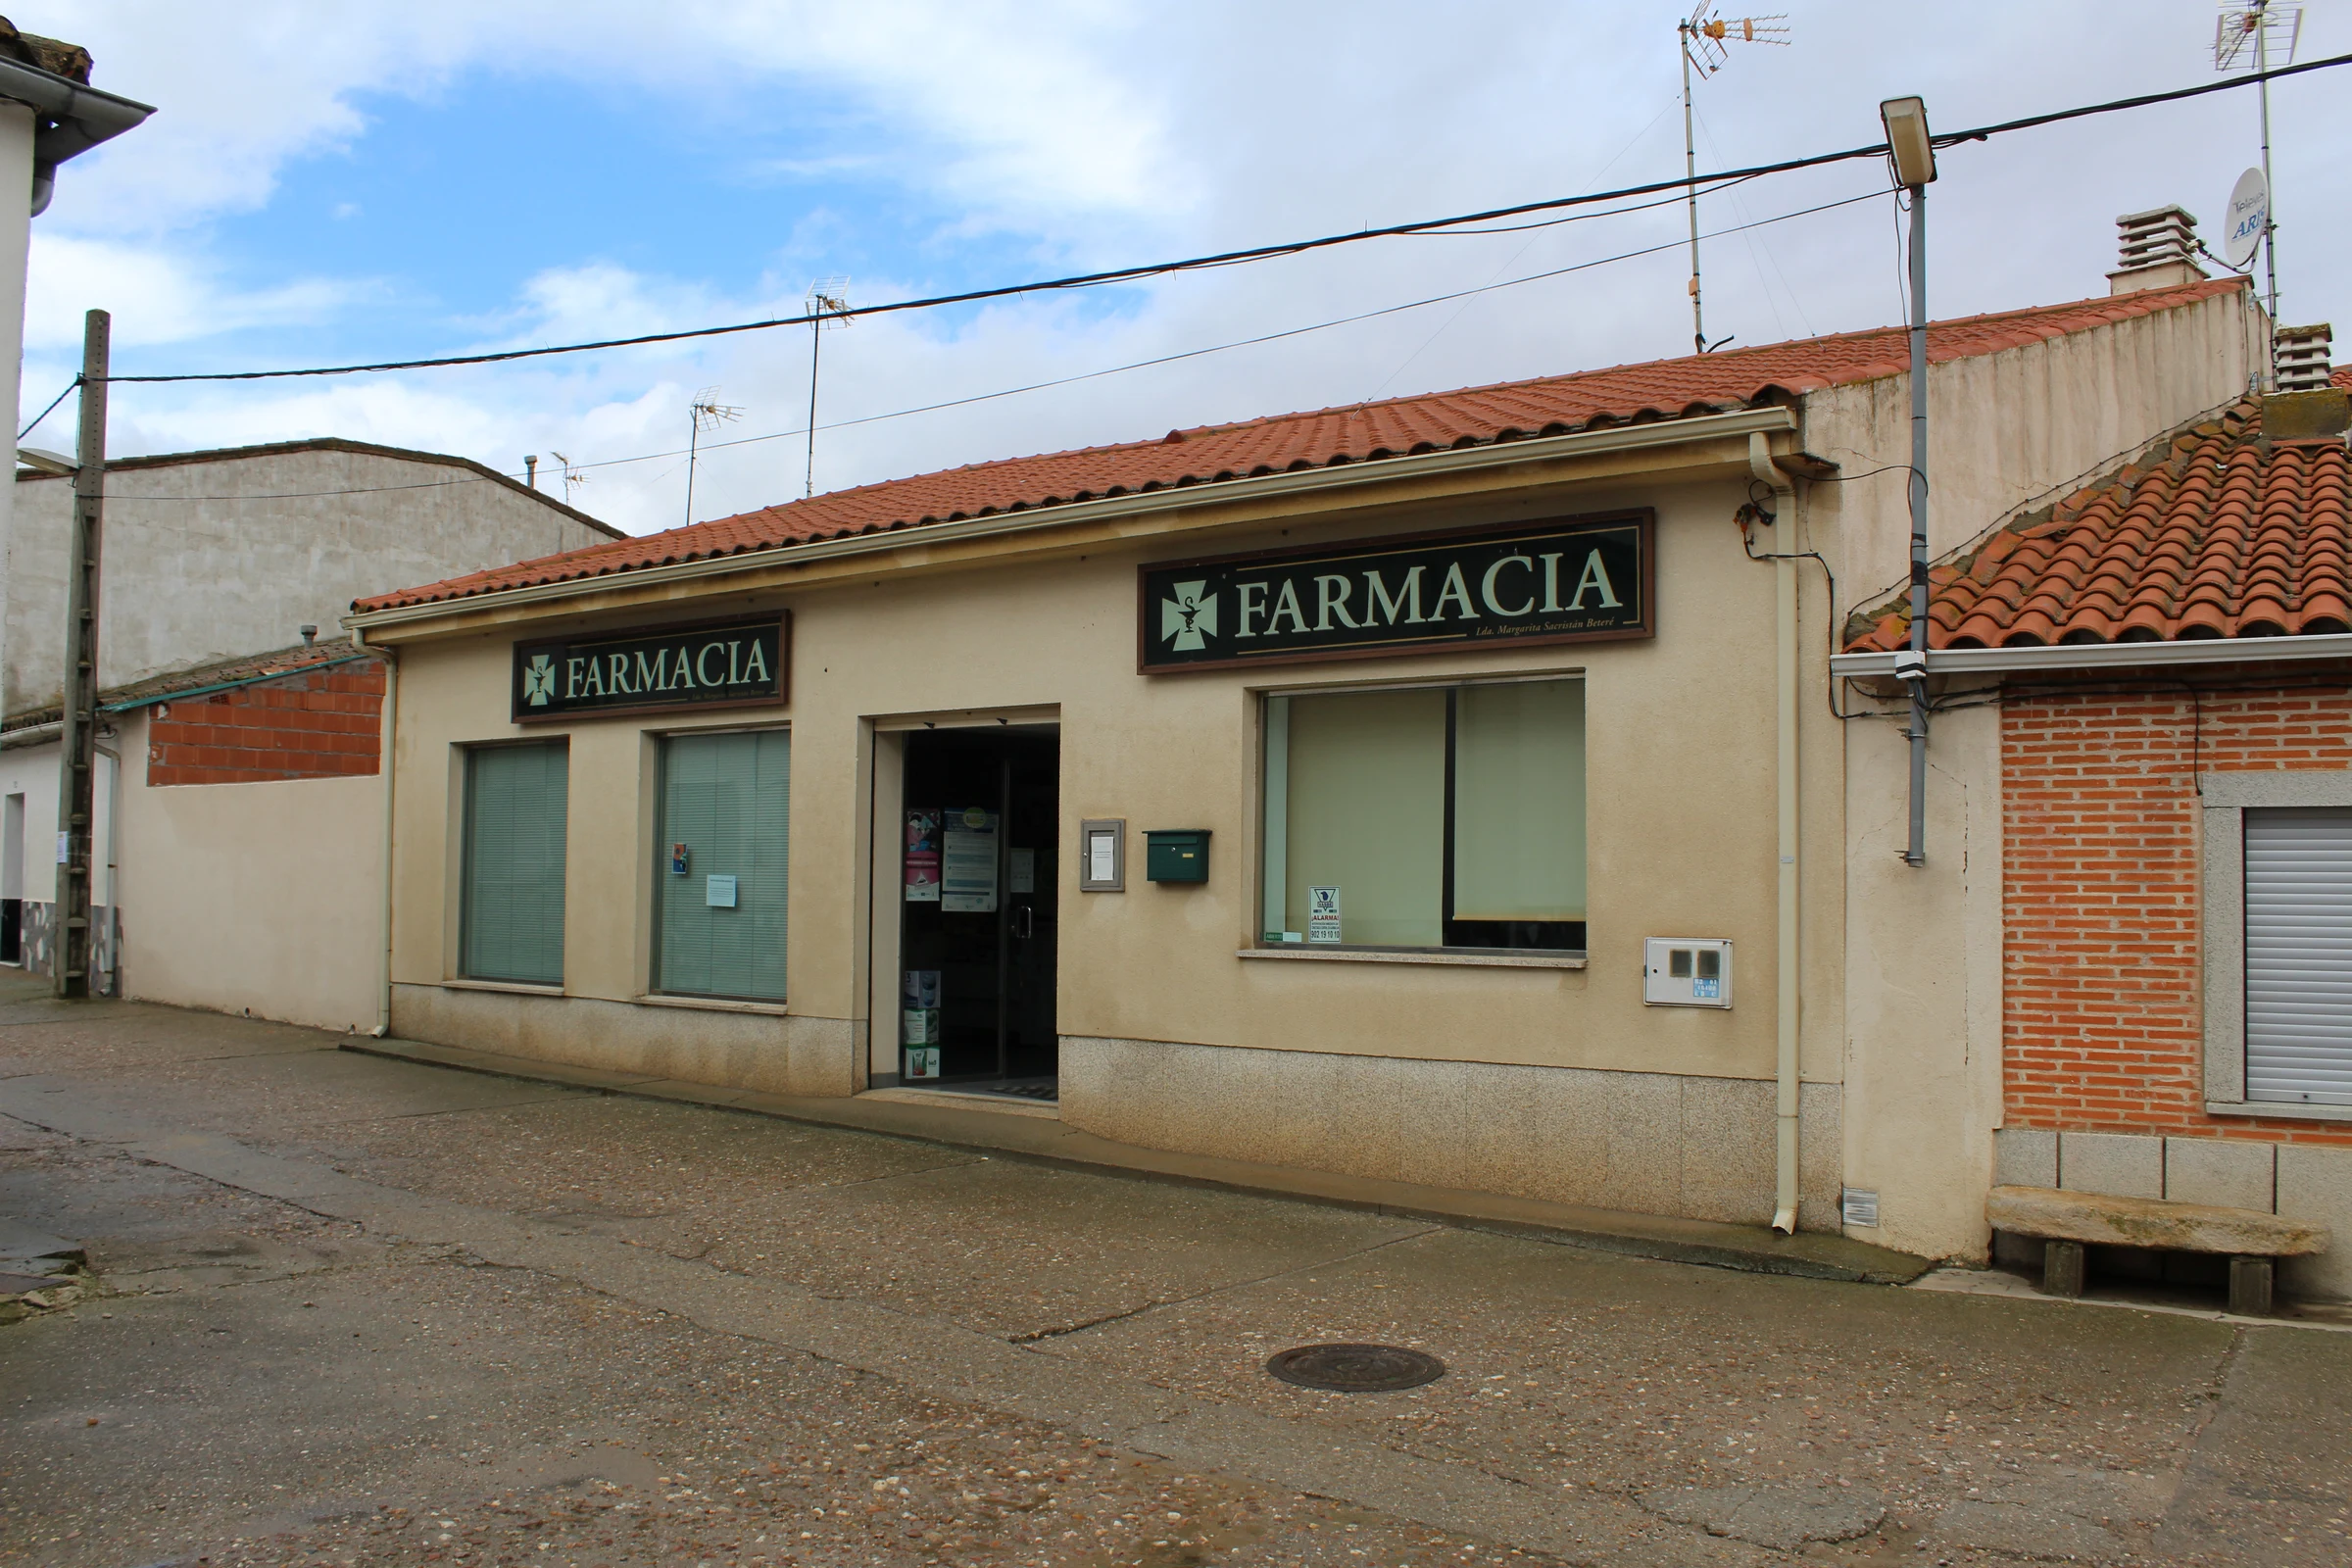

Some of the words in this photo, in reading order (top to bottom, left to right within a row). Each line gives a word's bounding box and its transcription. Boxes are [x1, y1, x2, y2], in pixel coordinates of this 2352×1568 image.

[1234, 548, 1623, 638] FARMACIA
[1476, 626, 1494, 636] Lda.
[1497, 623, 1542, 635] Margarita
[1544, 619, 1584, 631] Sacristán
[1586, 616, 1616, 628] Beteré
[564, 638, 771, 698] FARMACIA
